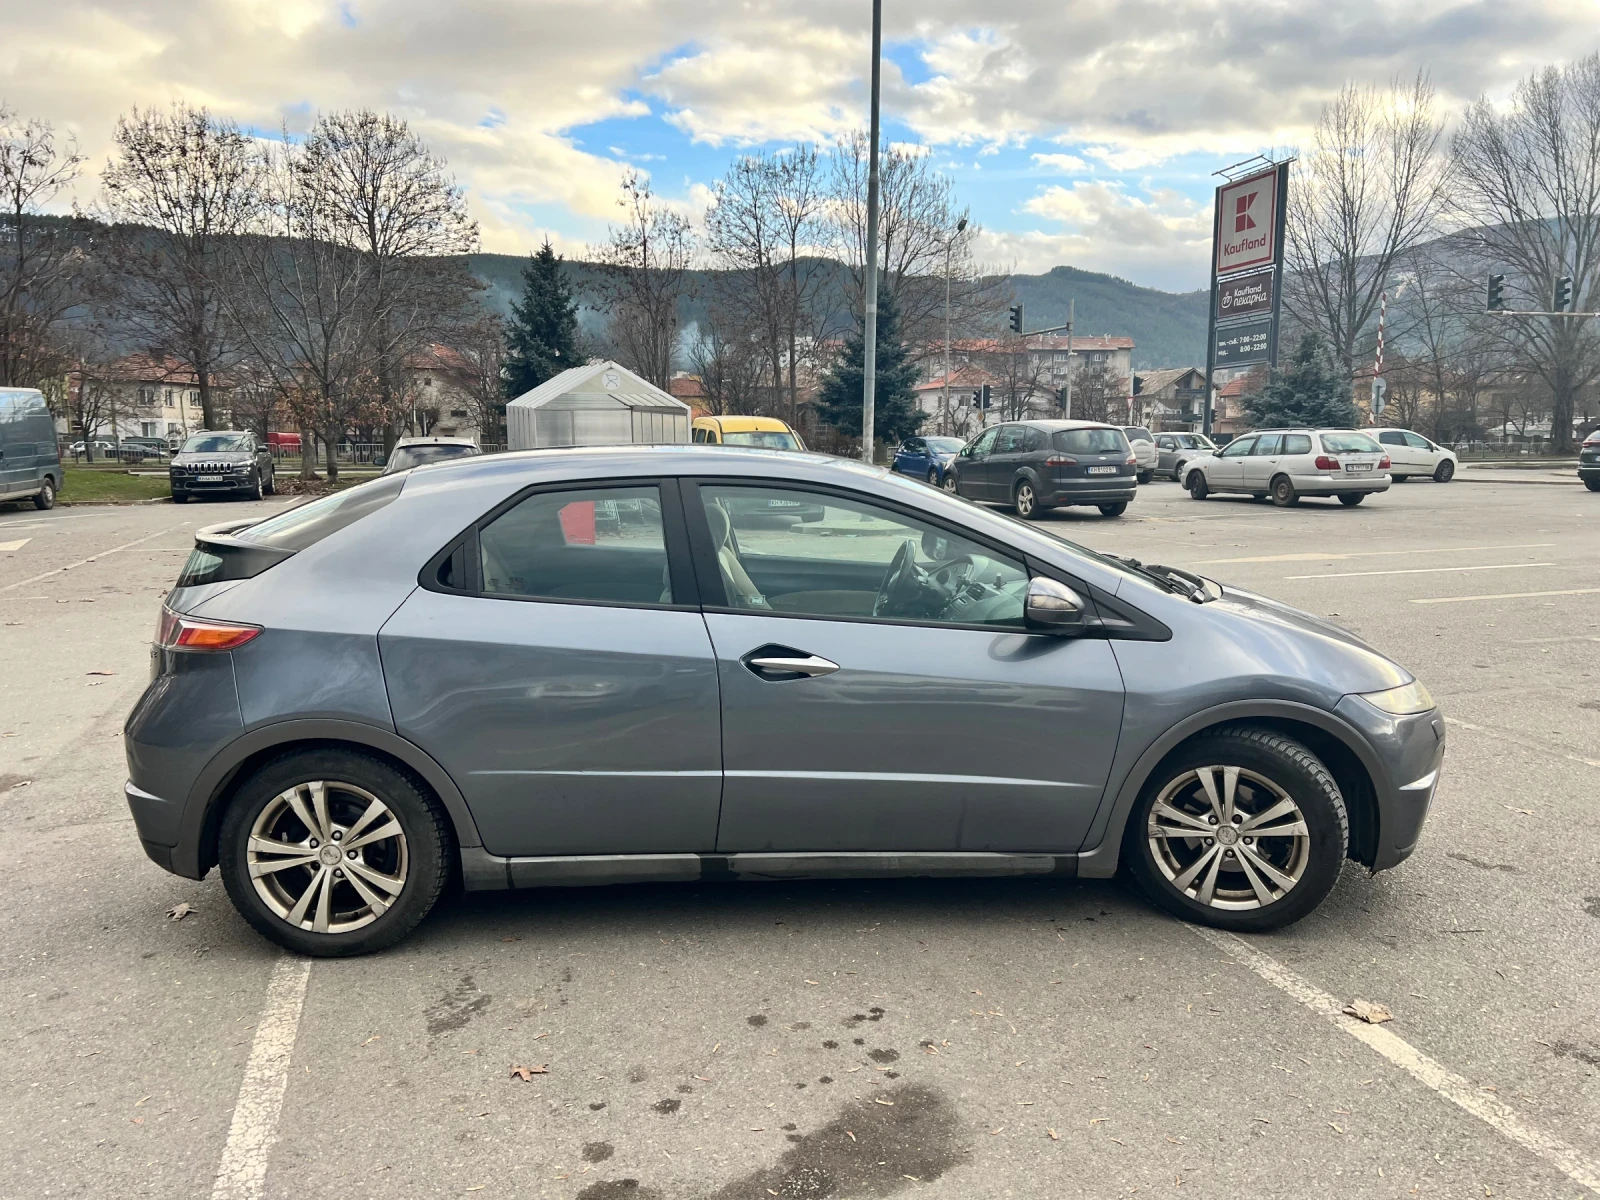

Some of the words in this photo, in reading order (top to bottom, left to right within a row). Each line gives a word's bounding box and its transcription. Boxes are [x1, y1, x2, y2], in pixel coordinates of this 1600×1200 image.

[1224, 233, 1266, 256] Kaufland
[1233, 283, 1262, 297] Kaufland
[1233, 292, 1268, 307] пекарна
